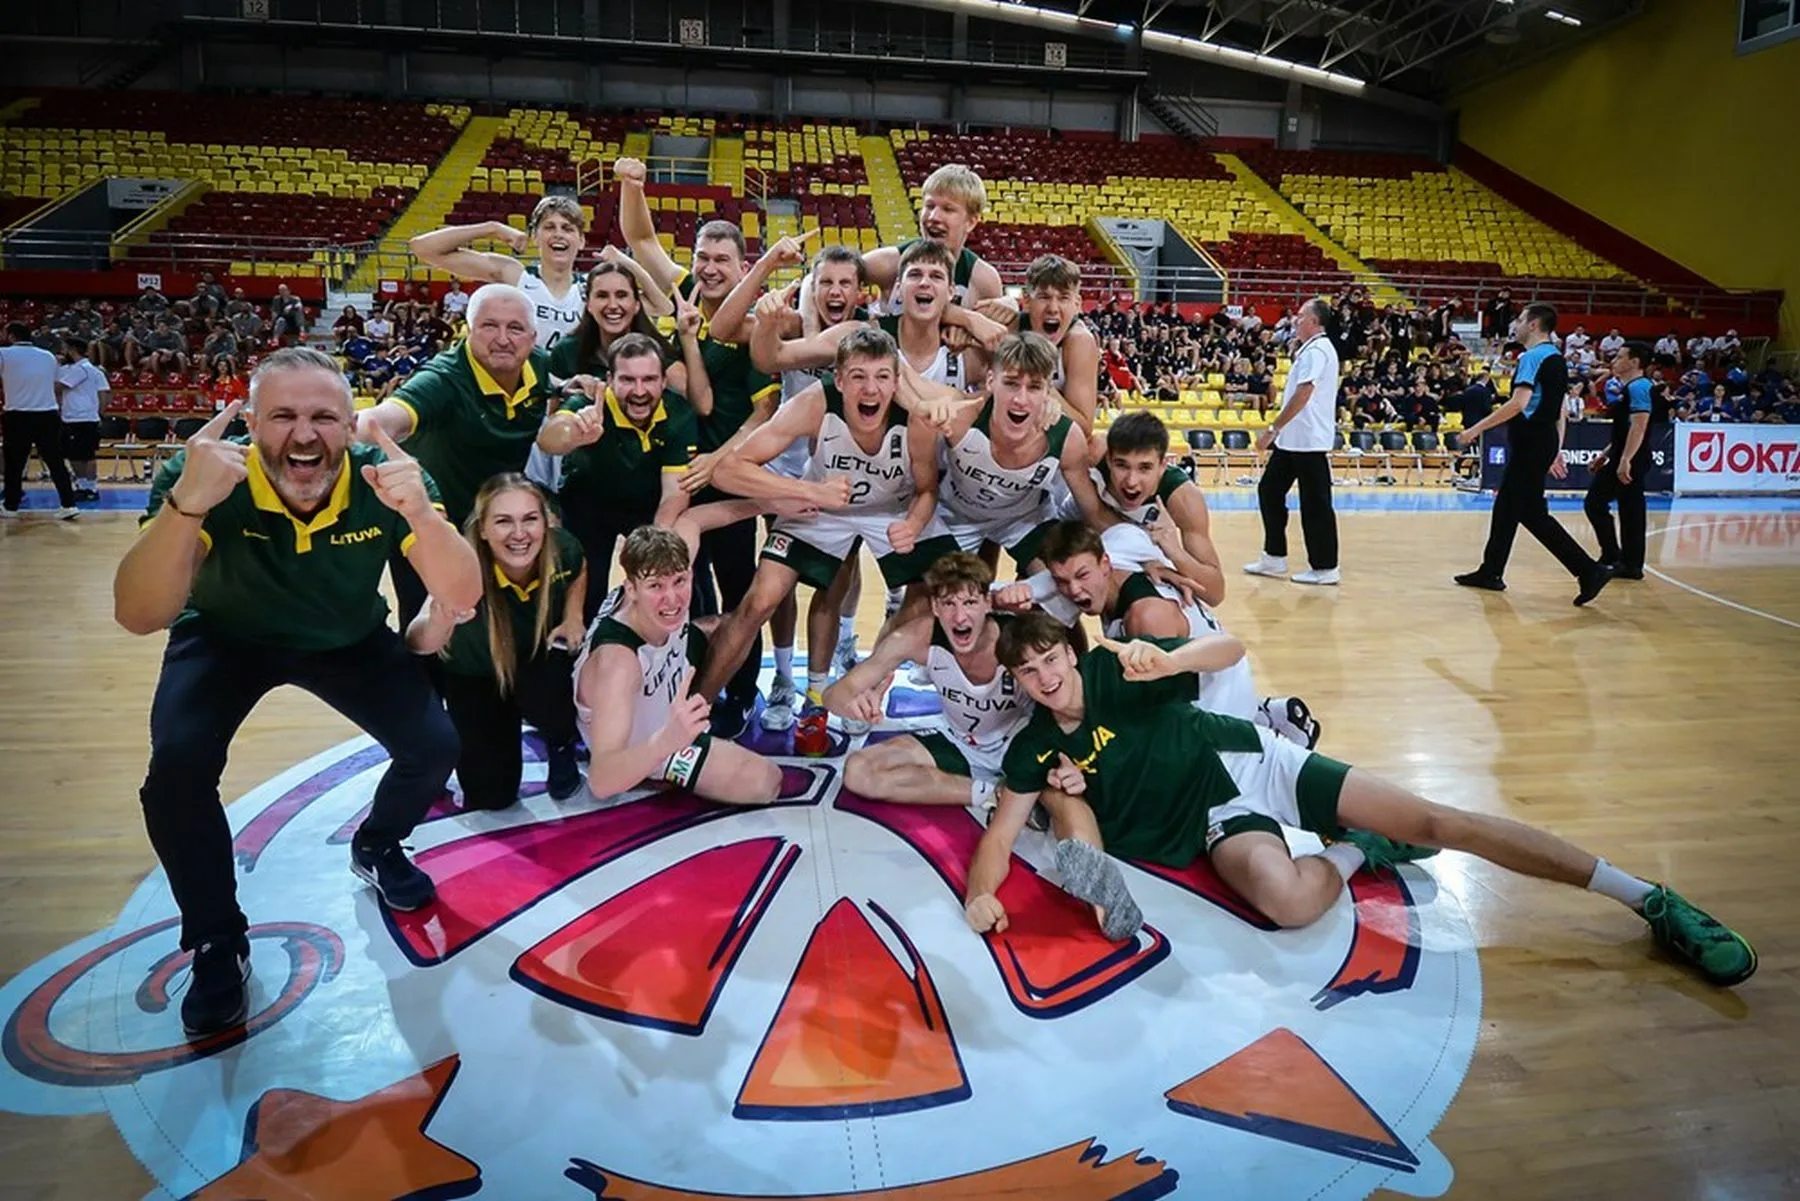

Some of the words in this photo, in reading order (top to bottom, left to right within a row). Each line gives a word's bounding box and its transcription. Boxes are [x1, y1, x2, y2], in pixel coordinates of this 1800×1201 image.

[250, 1, 264, 13] 12
[685, 27, 699, 39] 13
[848, 481, 872, 504] 2
[942, 686, 1017, 711] IETUVA
[963, 712, 980, 732] 7
